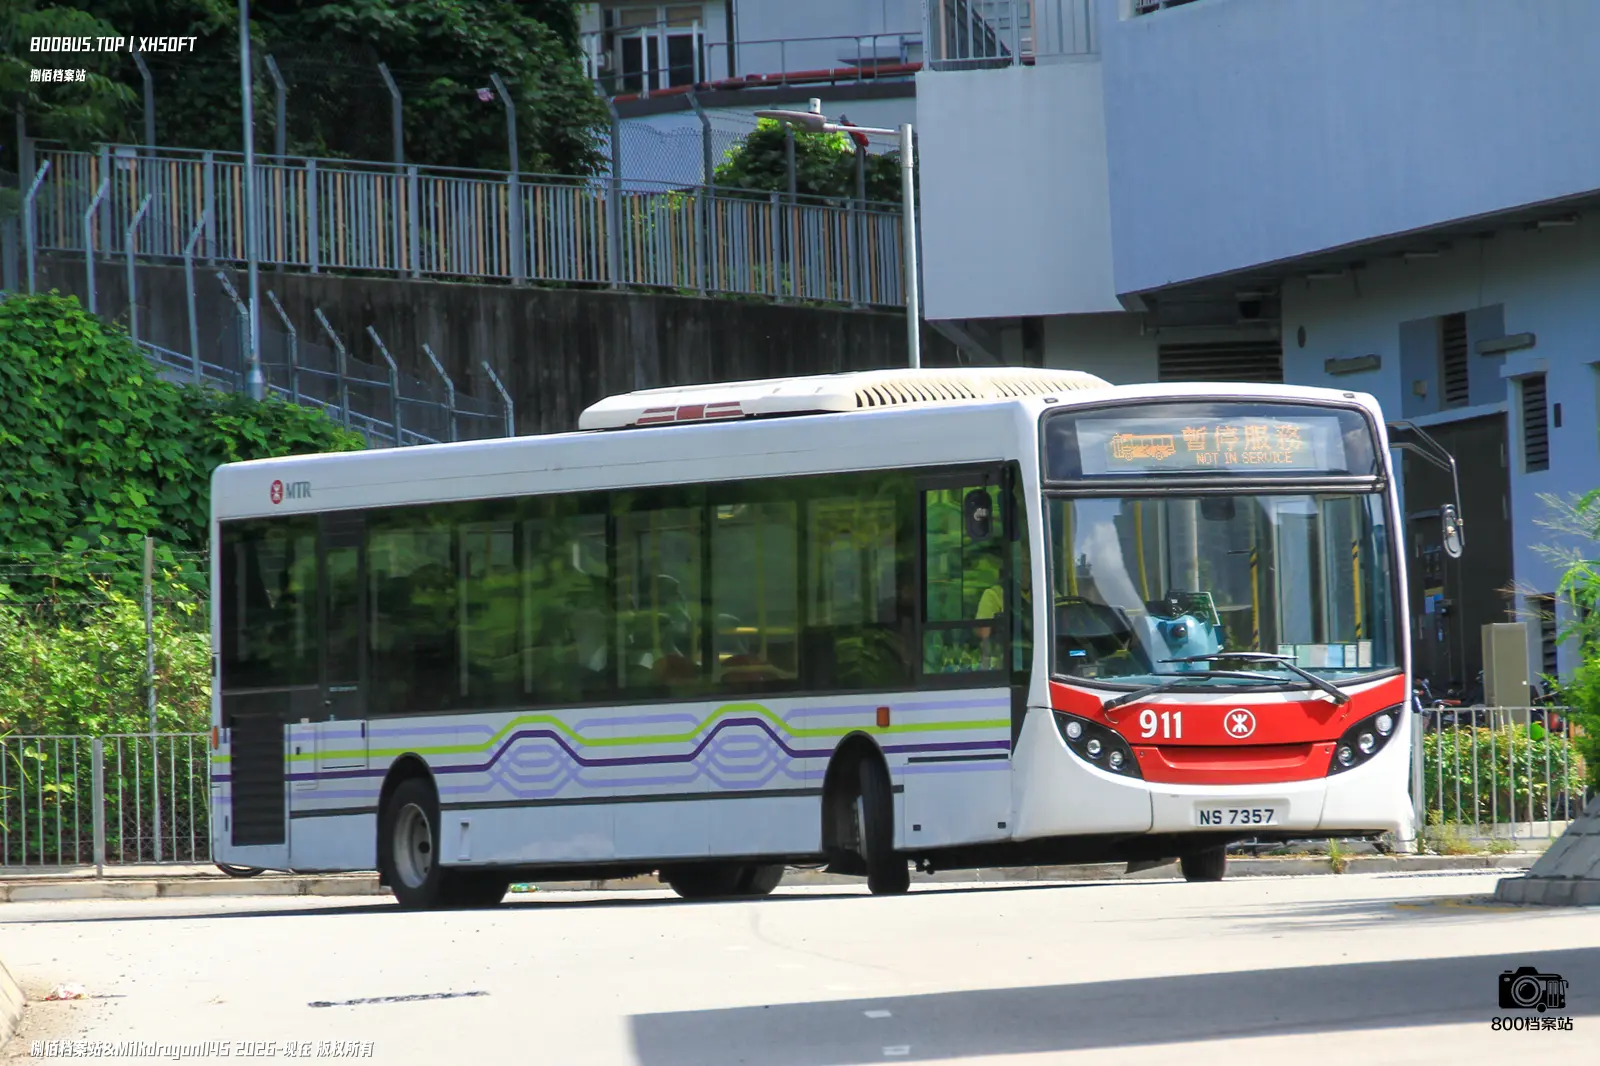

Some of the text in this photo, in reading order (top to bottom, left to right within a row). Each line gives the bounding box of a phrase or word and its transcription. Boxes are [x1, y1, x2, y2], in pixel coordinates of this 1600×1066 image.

[1181, 424, 1302, 452] 暫停服務
[1196, 451, 1293, 465] NOT IN SERVICE
[286, 481, 311, 499] MTR
[1139, 709, 1182, 739] 911
[1200, 809, 1274, 824] NS 7357
